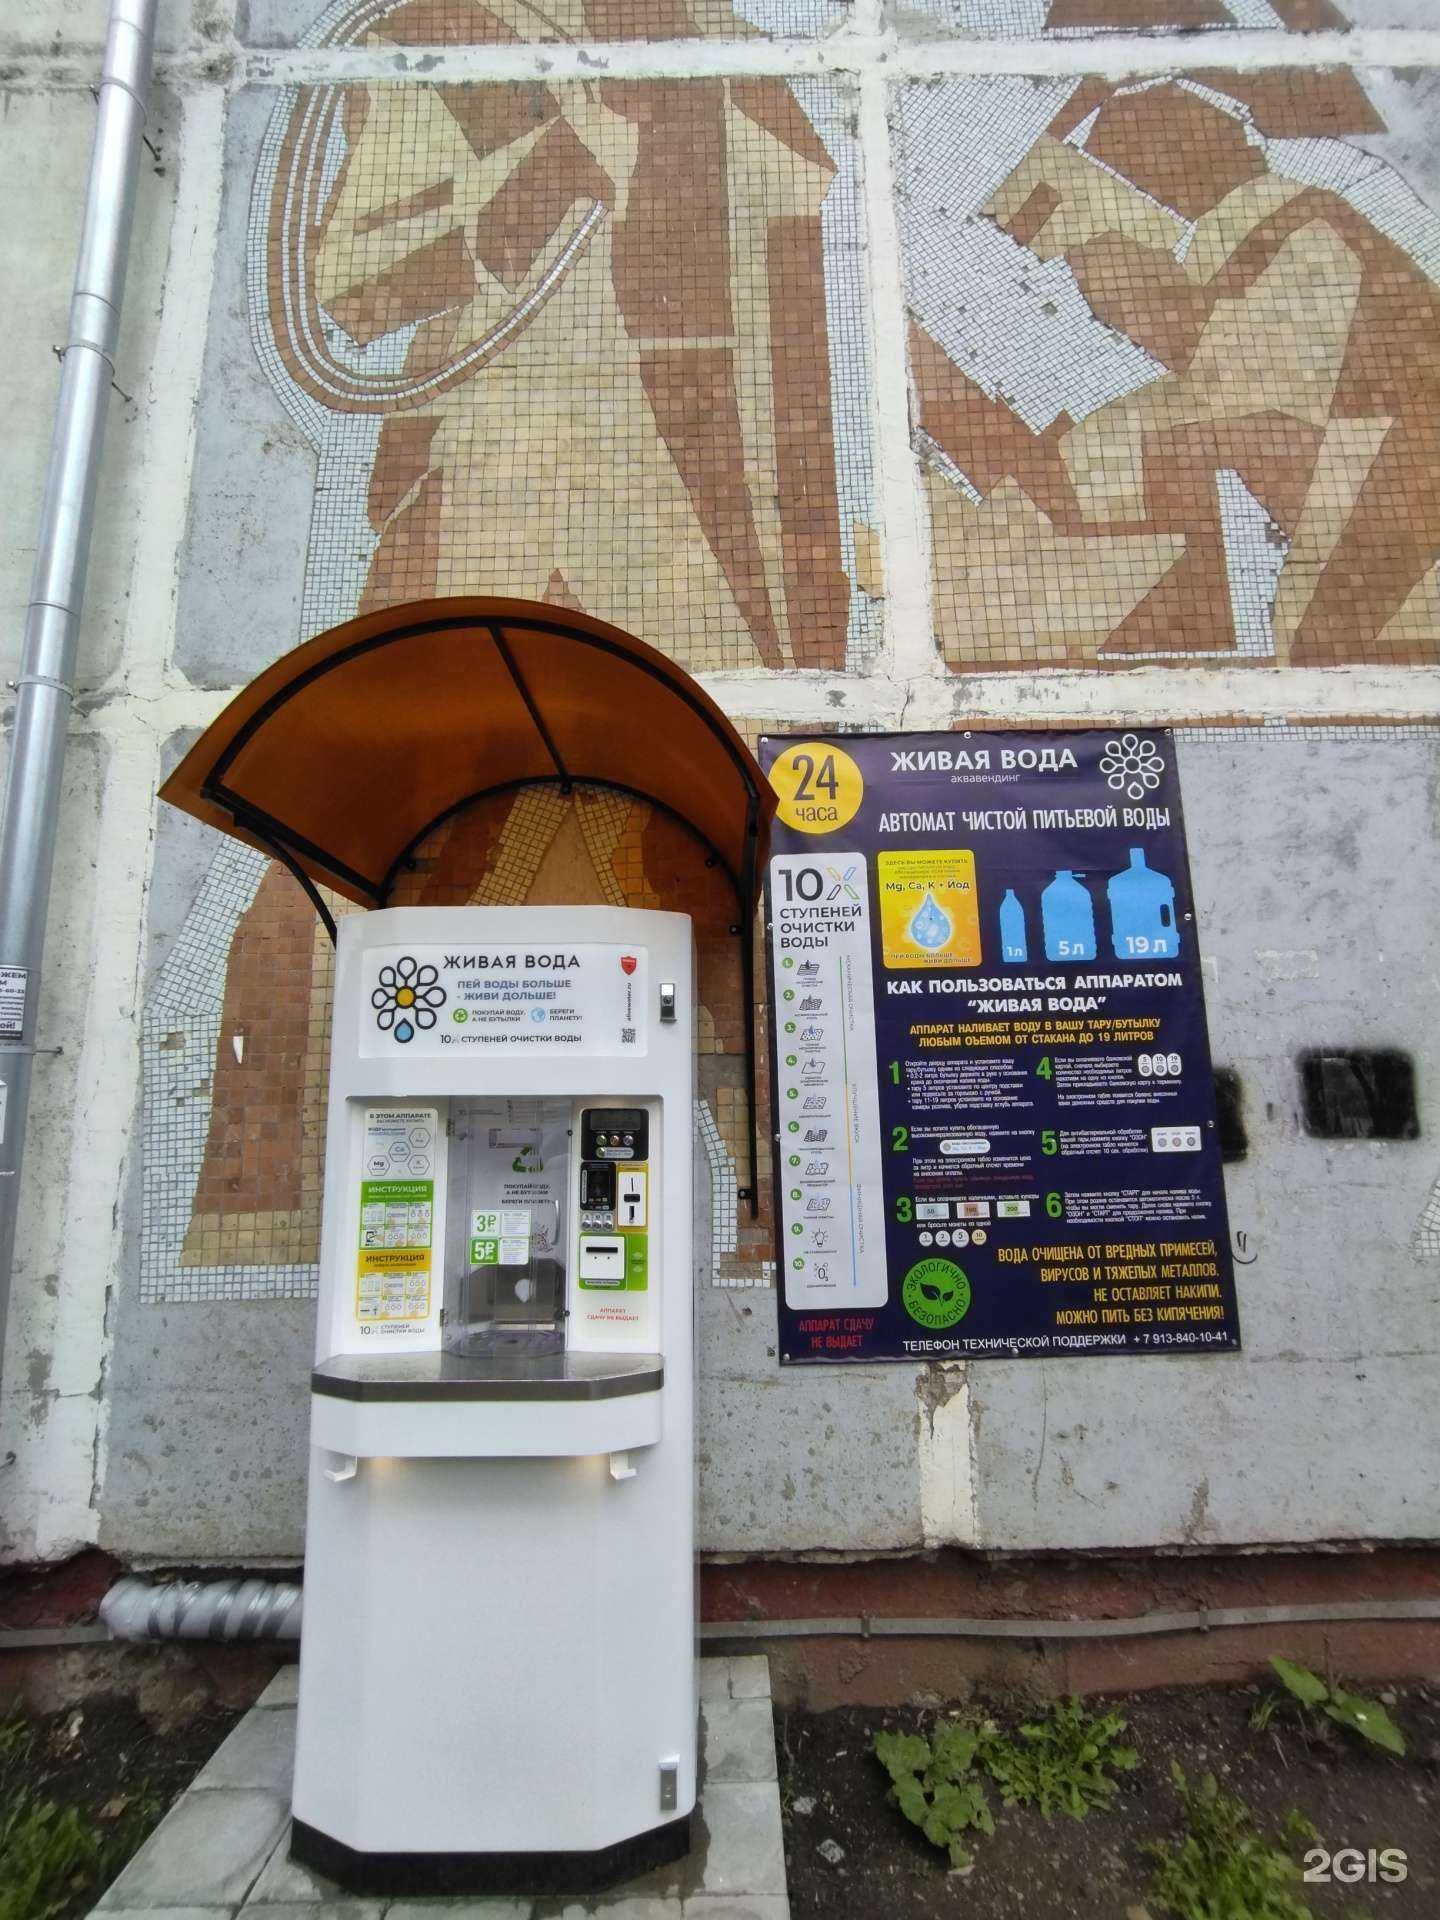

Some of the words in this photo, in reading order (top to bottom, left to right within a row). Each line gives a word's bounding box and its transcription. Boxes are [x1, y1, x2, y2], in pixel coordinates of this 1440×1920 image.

[890, 751, 990, 772] ЖИВАЯ
[1001, 748, 1078, 770] ВОДА
[792, 754, 840, 801] 24
[950, 773, 1021, 785] аквавендинг
[795, 806, 839, 823] часа
[879, 812, 956, 833] АВТОМАТ
[961, 806, 1027, 831] ЧИСТОЙ
[1032, 804, 1118, 829] ПИТЬЕВОЙ
[1124, 807, 1171, 829] ВОДЫ
[947, 879, 970, 890] Йод
[780, 904, 862, 919] СТУПЕНЕЙ
[781, 921, 855, 934] ОЧИСТКИ
[781, 937, 828, 949] ВОДЫ
[1126, 936, 1149, 953] 19
[443, 955, 517, 969] ЖИВАЯ
[525, 954, 580, 970] ВОДА
[457, 979, 481, 989] ПЕЙ
[484, 979, 519, 990] ВОДЫ
[522, 978, 572, 989] БОЛЬШЕ
[887, 981, 923, 994] КАК
[928, 976, 1067, 993] ПОЛЬЗОВАТЬСЯ
[1075, 973, 1183, 990] АППАРАТОМ
[464, 991, 498, 1001] ЖИВИ
[502, 990, 556, 1001] ДОЛЬШЕ!
[472, 1008, 505, 1016] ПОКУПАЙ
[910, 1024, 954, 1034] АППАРАТ
[958, 1023, 1009, 1033] НАЛИВАЕТ
[1014, 1022, 1041, 1032] ВОДУ
[1045, 1021, 1052, 1030] В
[1055, 1021, 1084, 1031] ВАШУ
[1088, 1018, 1160, 1030] ТАРУ/БУТЫЛКУ
[461, 1034, 508, 1043] СТУПЕНЕЙ
[510, 1035, 552, 1043] ОЧИСТКИ
[554, 1035, 582, 1043] ВОДЫ
[919, 1037, 961, 1047] ЛЮБЫМ
[1015, 1034, 1028, 1044] ОТ
[1031, 1033, 1075, 1044] СТАКАНА
[1079, 1032, 1094, 1044] ДО
[1098, 1032, 1110, 1042] 19
[1113, 1030, 1154, 1042] ЛИТРОВ
[889, 1061, 899, 1084] 1
[1036, 1056, 1052, 1080] 4
[892, 1127, 908, 1151] 2
[1041, 1131, 1058, 1155] 5
[896, 1197, 912, 1222] 3
[1045, 1192, 1062, 1217] 6
[366, 1254, 424, 1263] ИНСТРУКЦИЯ
[998, 1248, 1028, 1264] ВОДА
[1032, 1246, 1084, 1262] ОЧИЩЕНА
[1088, 1246, 1102, 1259] ОТ
[1106, 1243, 1156, 1260] ВРЕДНЫХ
[1160, 1240, 1218, 1257] ПРИМЕСЕЙ,
[906, 1262, 966, 1291] ЭКОЛОГИЧНО
[1041, 1267, 1089, 1282] ВИРУСОВ
[1093, 1268, 1101, 1280] И
[1105, 1265, 1157, 1280] ТЯЖЕЛЫХ
[1161, 1263, 1220, 1278] МЕТАЛЛОВ.
[1094, 1288, 1108, 1302] НЕ
[1112, 1286, 1172, 1301] ОСТАВЛЯЕТ
[1175, 1284, 1222, 1299] НАКИПИ.
[908, 1298, 967, 1325] БЕЗОПАСНО
[1056, 1310, 1098, 1325] МОЖНО
[1102, 1309, 1130, 1323] ПИТЬ
[1135, 1308, 1153, 1322] БЕЗ
[1157, 1305, 1224, 1321] КИПЯЧЕНИЯ!
[799, 1319, 841, 1331] АППАРАТ
[843, 1318, 875, 1331] СДАЧУ
[811, 1337, 824, 1348] НЕ
[826, 1335, 864, 1348] ВЫДАЕТ
[903, 1338, 960, 1352] ТЕЛЕФОН
[962, 1334, 1049, 1350] ТЕХНИЧЕСКОЙ
[1052, 1333, 1127, 1348] ПОДДЕРЖКИ
[1143, 1334, 1149, 1344] 7
[1152, 1331, 1228, 1344] 913-840-10-41
